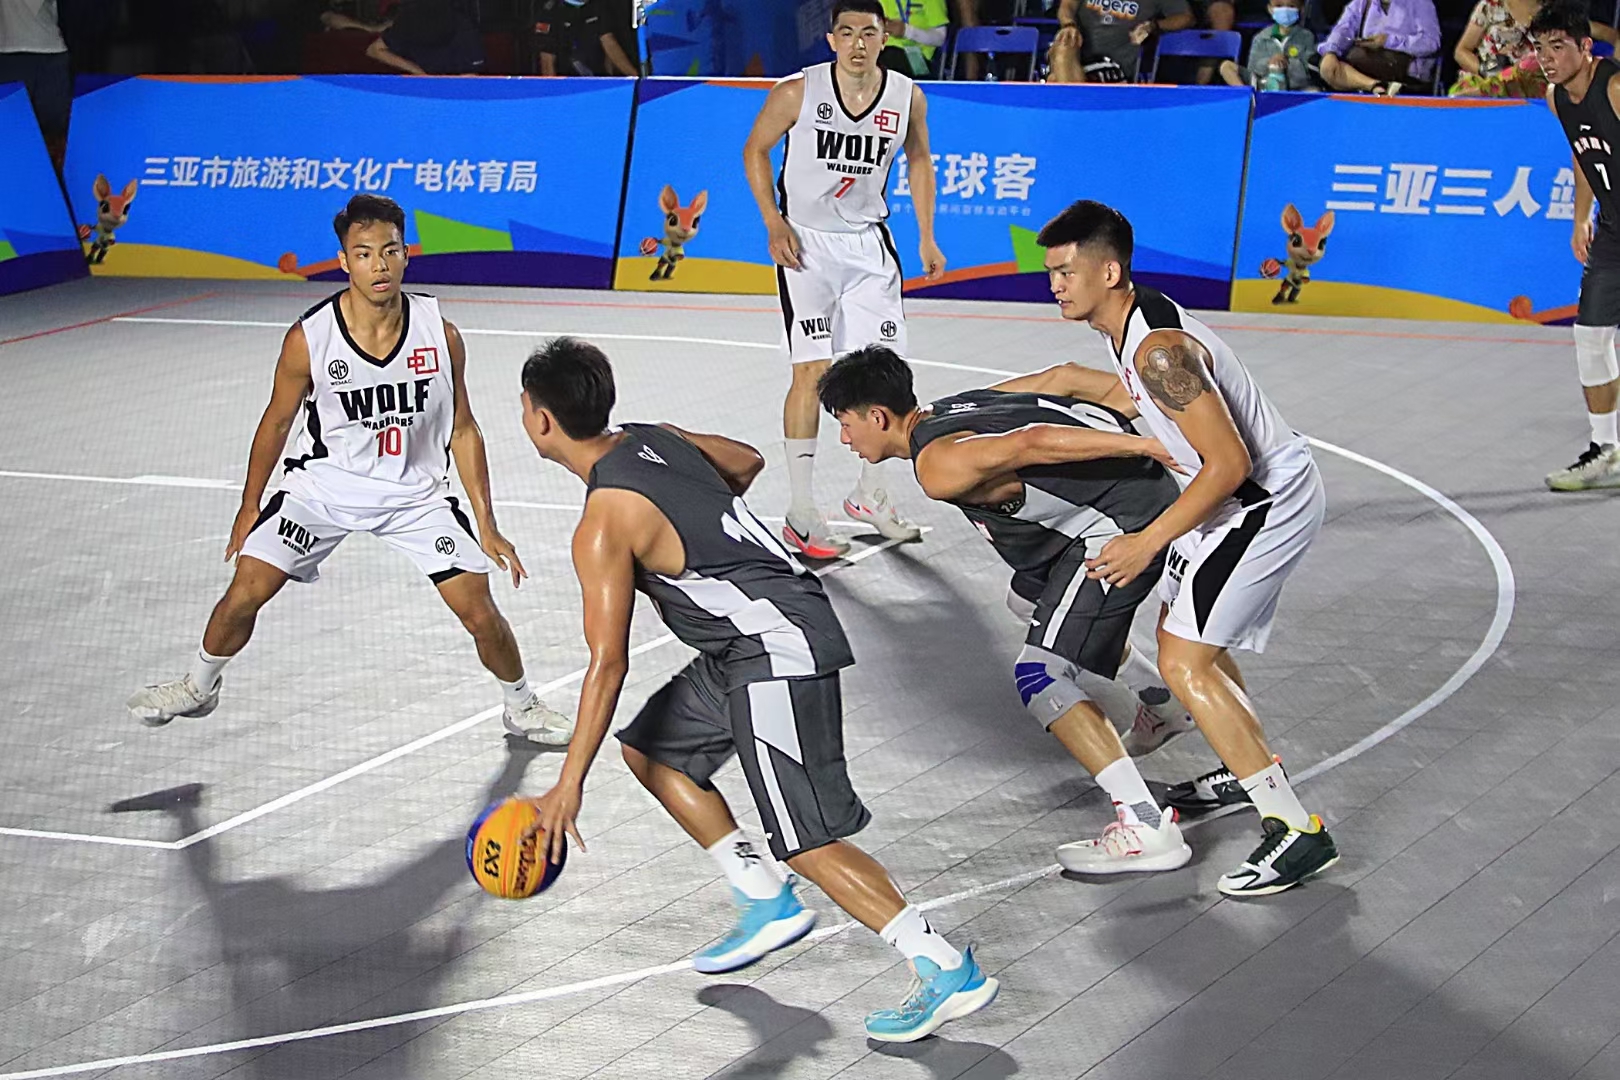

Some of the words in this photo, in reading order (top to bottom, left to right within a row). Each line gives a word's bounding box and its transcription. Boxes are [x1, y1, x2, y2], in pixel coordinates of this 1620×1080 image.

[814, 127, 894, 167] WOLF
[140, 155, 538, 193] 三亚市旅游和文化广电体育局
[826, 162, 874, 175] WARRIORS
[834, 176, 856, 199] 7
[333, 377, 435, 422] WOLF
[361, 415, 414, 431] WARRIORS
[376, 427, 402, 459] 10
